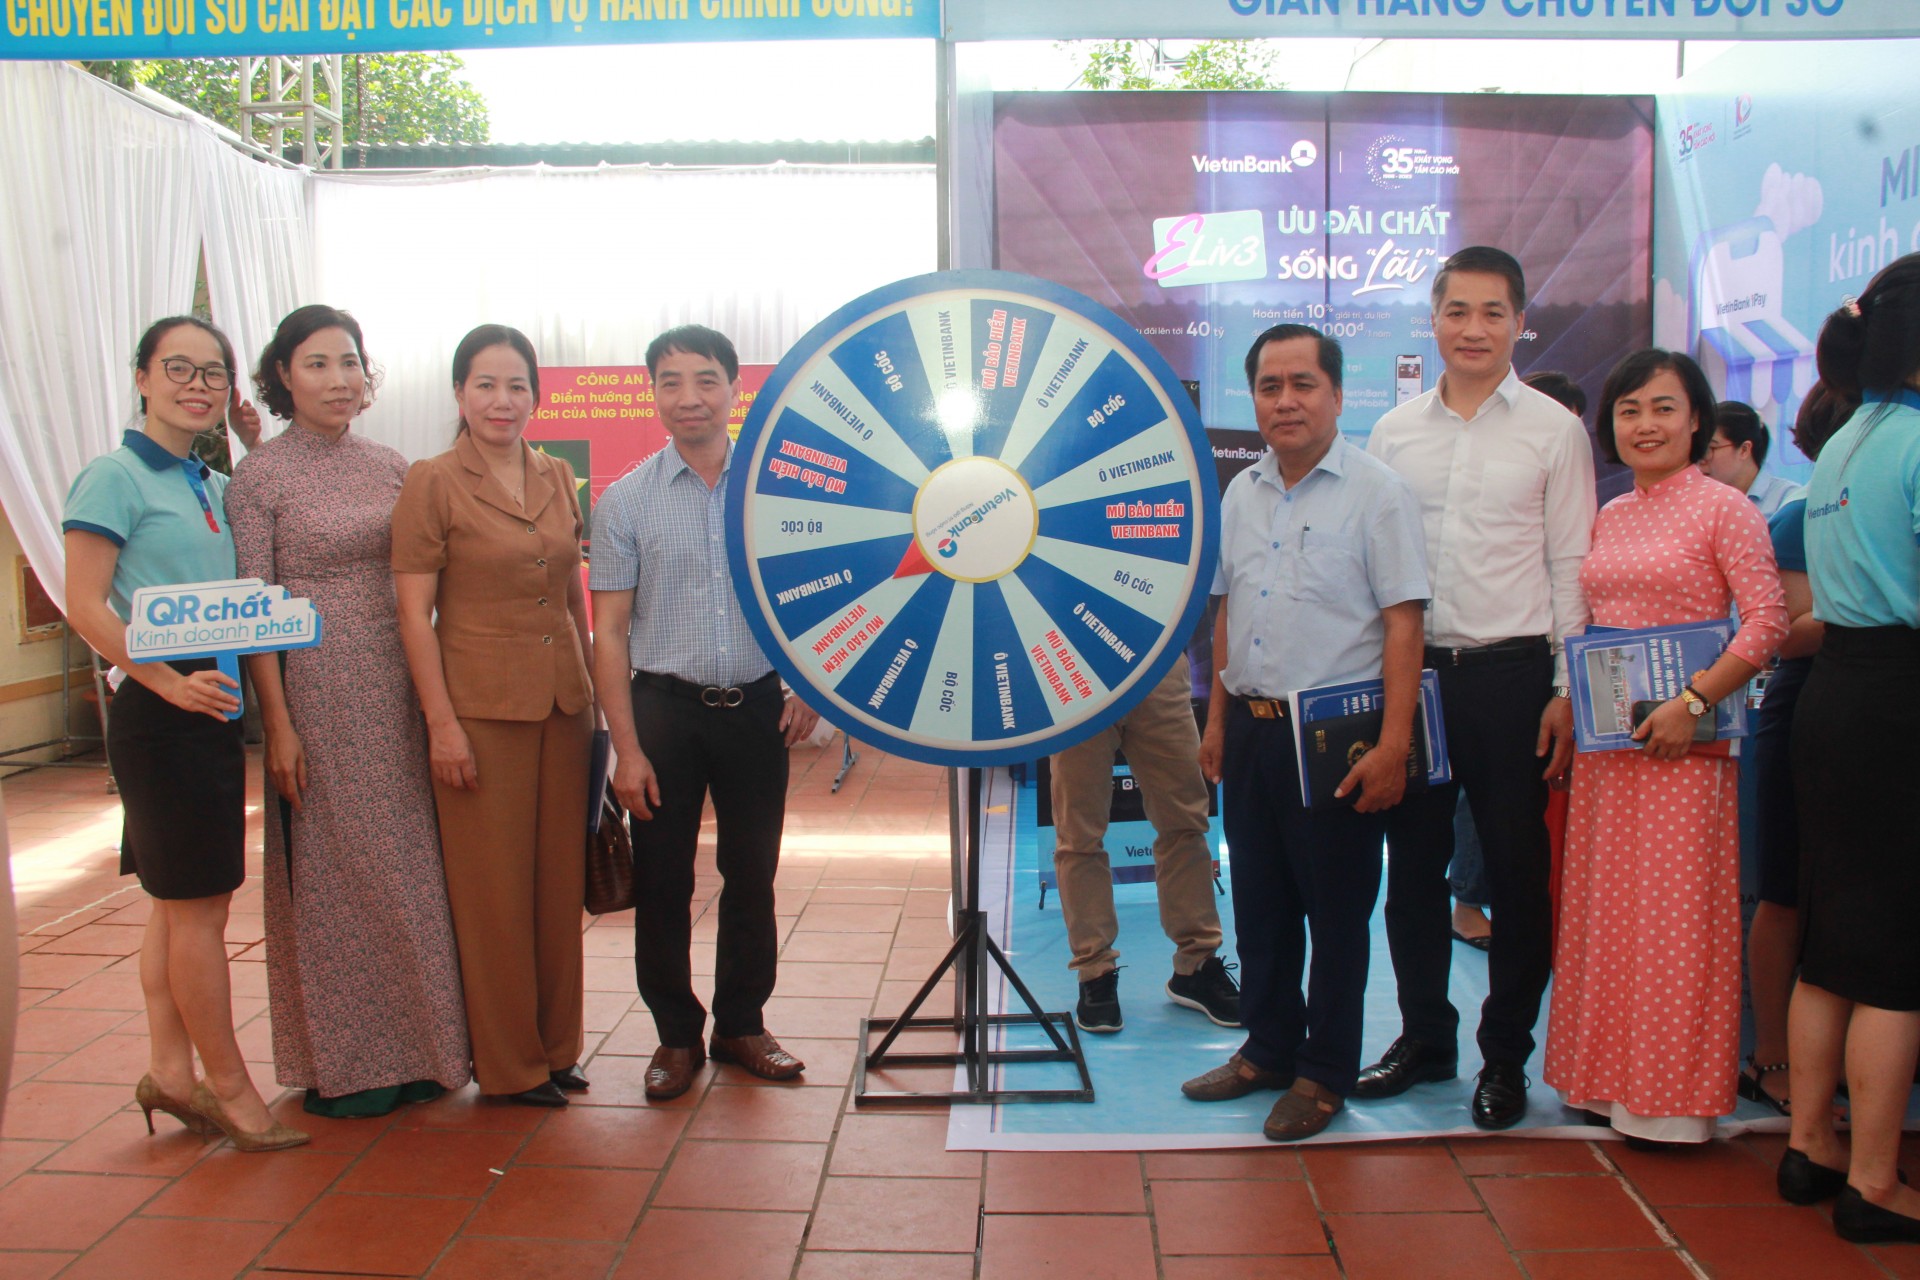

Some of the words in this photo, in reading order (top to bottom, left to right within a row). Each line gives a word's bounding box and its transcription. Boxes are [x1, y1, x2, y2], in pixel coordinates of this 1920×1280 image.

[1191, 154, 1293, 174] VietinBank
[1381, 147, 1414, 174] 35
[1278, 205, 1316, 234] ƯU
[1323, 206, 1372, 234] ĐÃI
[1380, 204, 1451, 235] CHẤT
[1278, 249, 1359, 280] SỐNG
[1253, 309, 1281, 319] Hoàn
[1284, 308, 1304, 319] tiền
[1716, 297, 1750, 316] VietinBank
[986, 309, 1008, 342] HIỂM
[1186, 322, 1210, 337] 40
[937, 309, 957, 385] VIETINBANK
[984, 342, 1002, 369] BẢO
[1002, 316, 1027, 388] VIETINBANK
[576, 372, 620, 386] CÔNG
[623, 374, 643, 385] AN
[1043, 337, 1089, 398] VIETINBANK
[550, 389, 586, 403] Điểm
[589, 391, 632, 405] hướng
[636, 388, 655, 402] dẫ
[884, 374, 904, 393] BỘ
[562, 406, 587, 419] CỦA
[591, 406, 617, 419] ỨNG
[620, 408, 655, 420] DỤNG
[809, 379, 868, 434] VIETINBANK
[1086, 410, 1106, 429] BỘ
[1102, 394, 1127, 417] CỐC
[768, 458, 802, 480] HIỂM
[779, 439, 848, 473] VIETINBANK
[1109, 450, 1176, 480] VIETINBANK
[800, 470, 827, 489] BẢO
[826, 476, 847, 494] MŨ
[1106, 502, 1126, 519] MŨ
[1127, 501, 1152, 519] BẢO
[1154, 498, 1185, 518] HIỂM
[807, 518, 823, 535] BỘ
[1111, 524, 1180, 540] VIETINBANK
[775, 572, 844, 606] VIETINBANK
[1113, 569, 1131, 587] BỘ
[1131, 577, 1155, 596] CỐC
[146, 594, 201, 627] QR
[203, 591, 273, 622] chất
[136, 628, 178, 648] Kinh
[183, 622, 250, 643] doanh
[811, 603, 868, 657] VIETINBANK
[864, 615, 885, 635] MŨ
[1072, 601, 1086, 616] Ô
[1080, 610, 1137, 664] VIETINBANK
[848, 629, 870, 653] BẢO
[821, 647, 850, 675] HIỂM
[1030, 643, 1073, 706] VIETINBANK
[1044, 629, 1064, 649] MŨ
[1055, 647, 1077, 672] BẢO
[1068, 670, 1093, 699] HIỂM
[867, 647, 914, 710] VIETINBANK
[941, 670, 958, 688] BỘ
[939, 688, 957, 713] CỐC
[994, 662, 1016, 730] VIETINBANK
